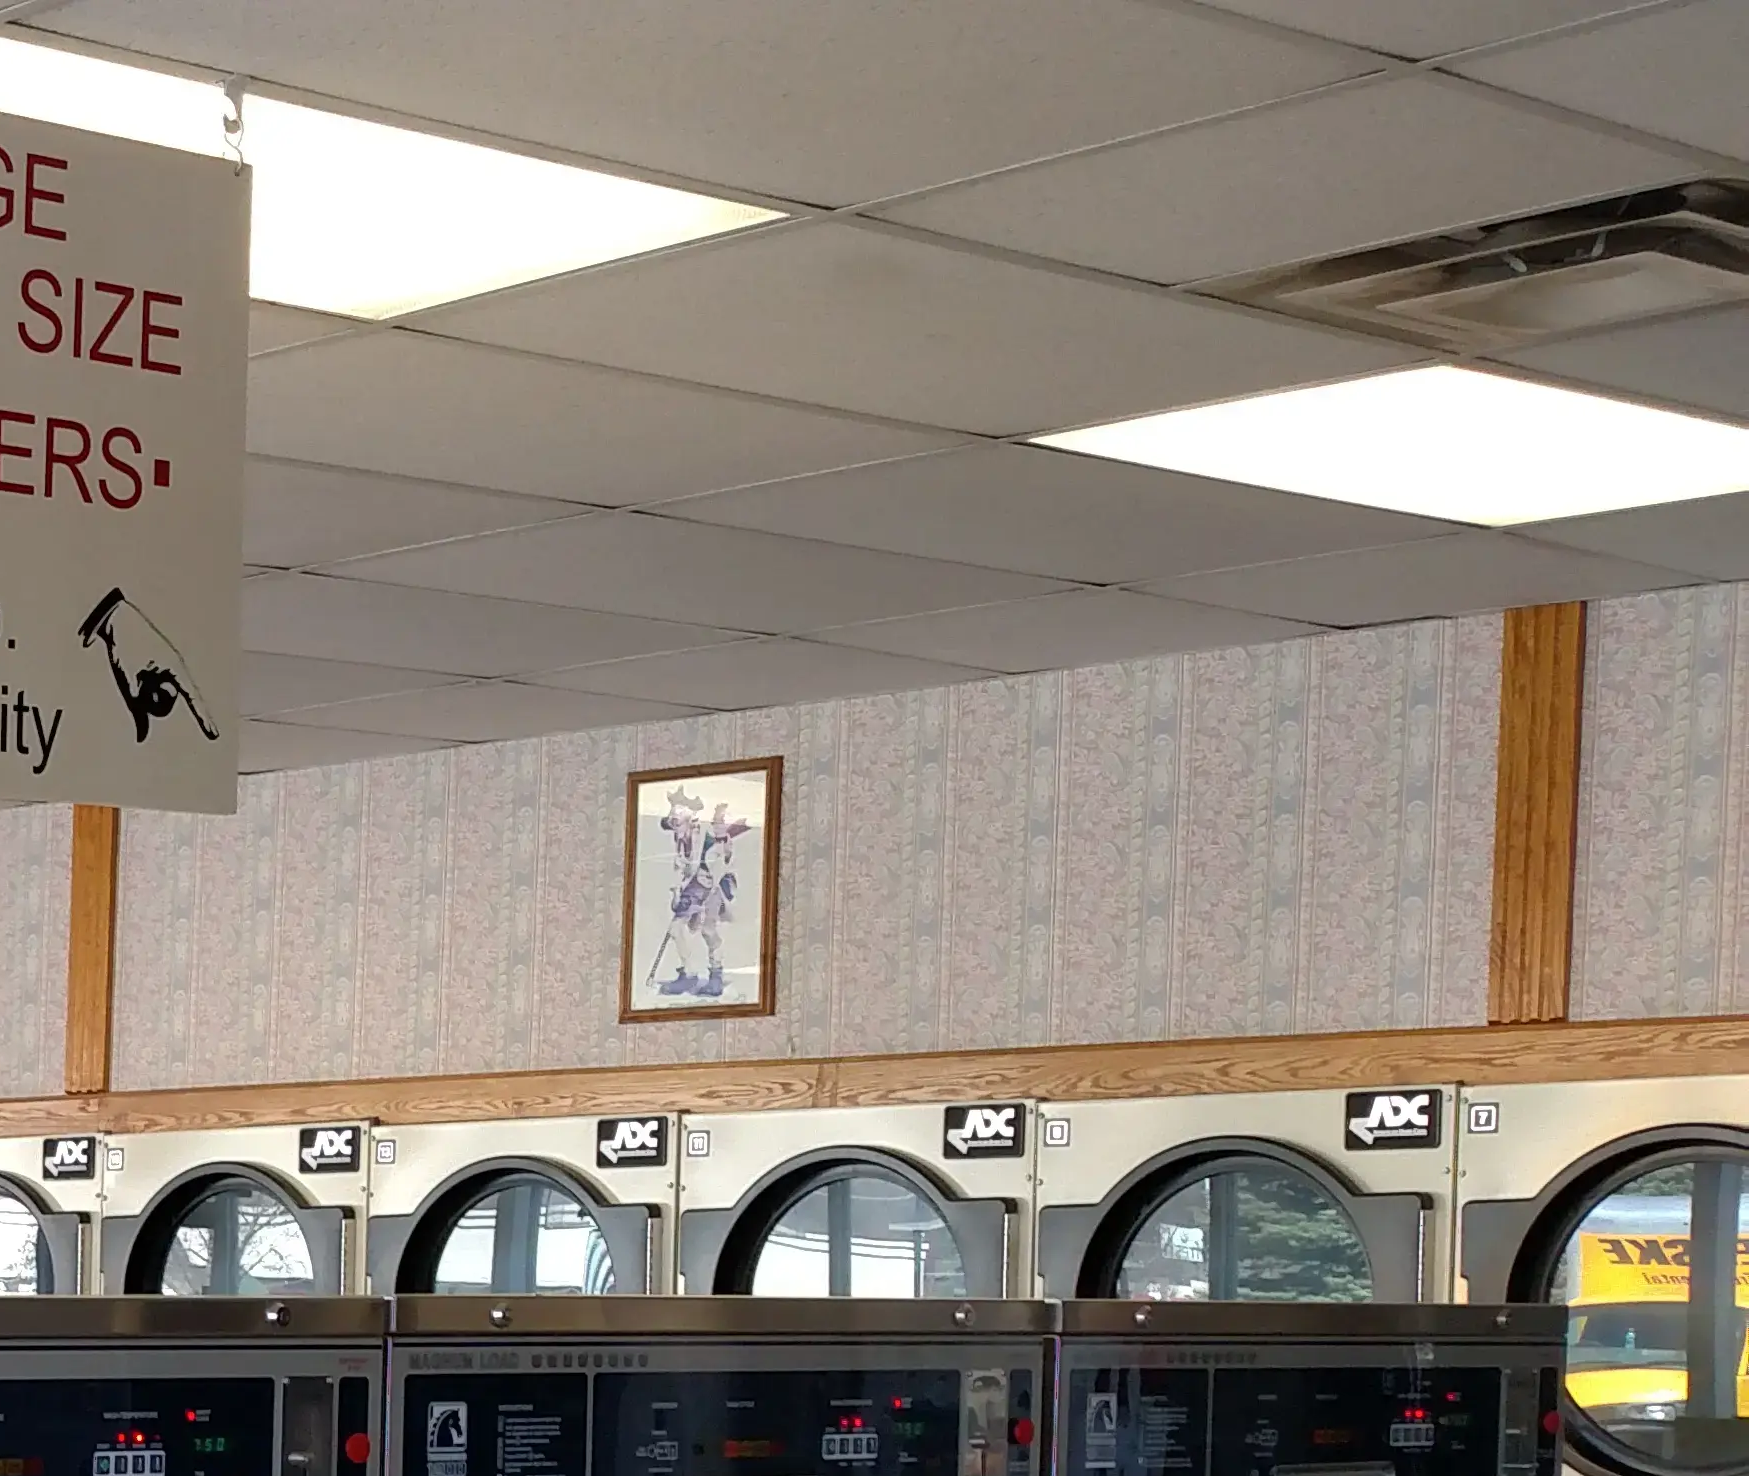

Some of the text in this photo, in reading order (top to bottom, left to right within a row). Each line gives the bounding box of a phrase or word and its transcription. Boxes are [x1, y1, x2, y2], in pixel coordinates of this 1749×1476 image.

[17, 269, 184, 376] SIZE
[962, 1107, 1015, 1138] ADC
[1366, 1094, 1430, 1127] ADC
[313, 1130, 353, 1156] ADC
[612, 1120, 658, 1148] ADC
[53, 1140, 88, 1165] ADC
